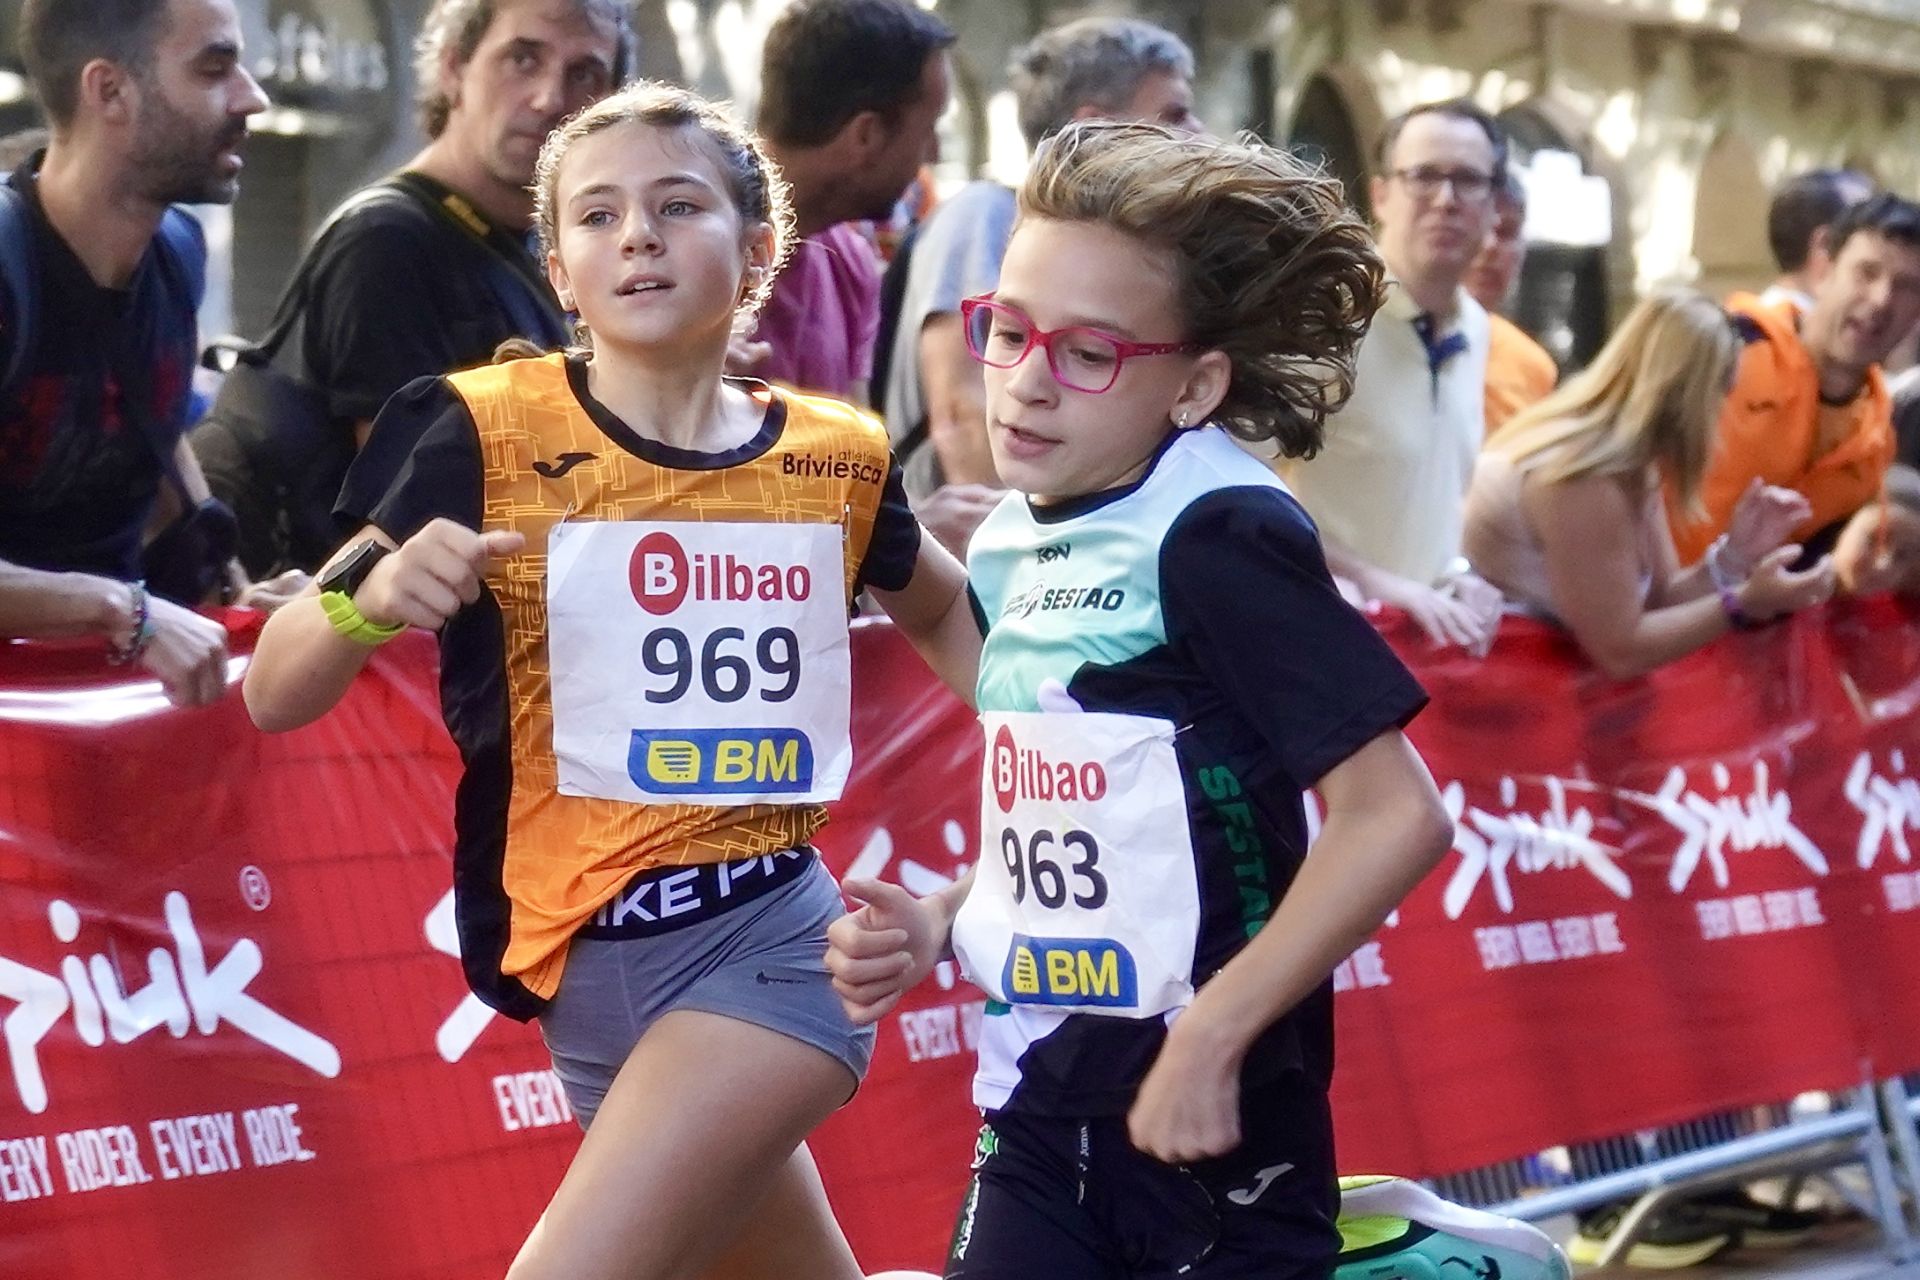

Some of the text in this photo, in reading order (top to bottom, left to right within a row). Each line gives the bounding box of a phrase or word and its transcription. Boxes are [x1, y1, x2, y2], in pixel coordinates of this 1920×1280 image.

[783, 453, 882, 485] Briviesca
[639, 547, 811, 605] Bilbao
[1041, 588, 1125, 611] SESTAO
[641, 627, 801, 703] 969
[713, 740, 799, 783] BM
[995, 739, 1108, 805] Bilbao
[587, 866, 702, 927] IKE
[1001, 827, 1108, 910] 963
[1048, 946, 1120, 997] BM
[150, 1112, 242, 1180] EVERY
